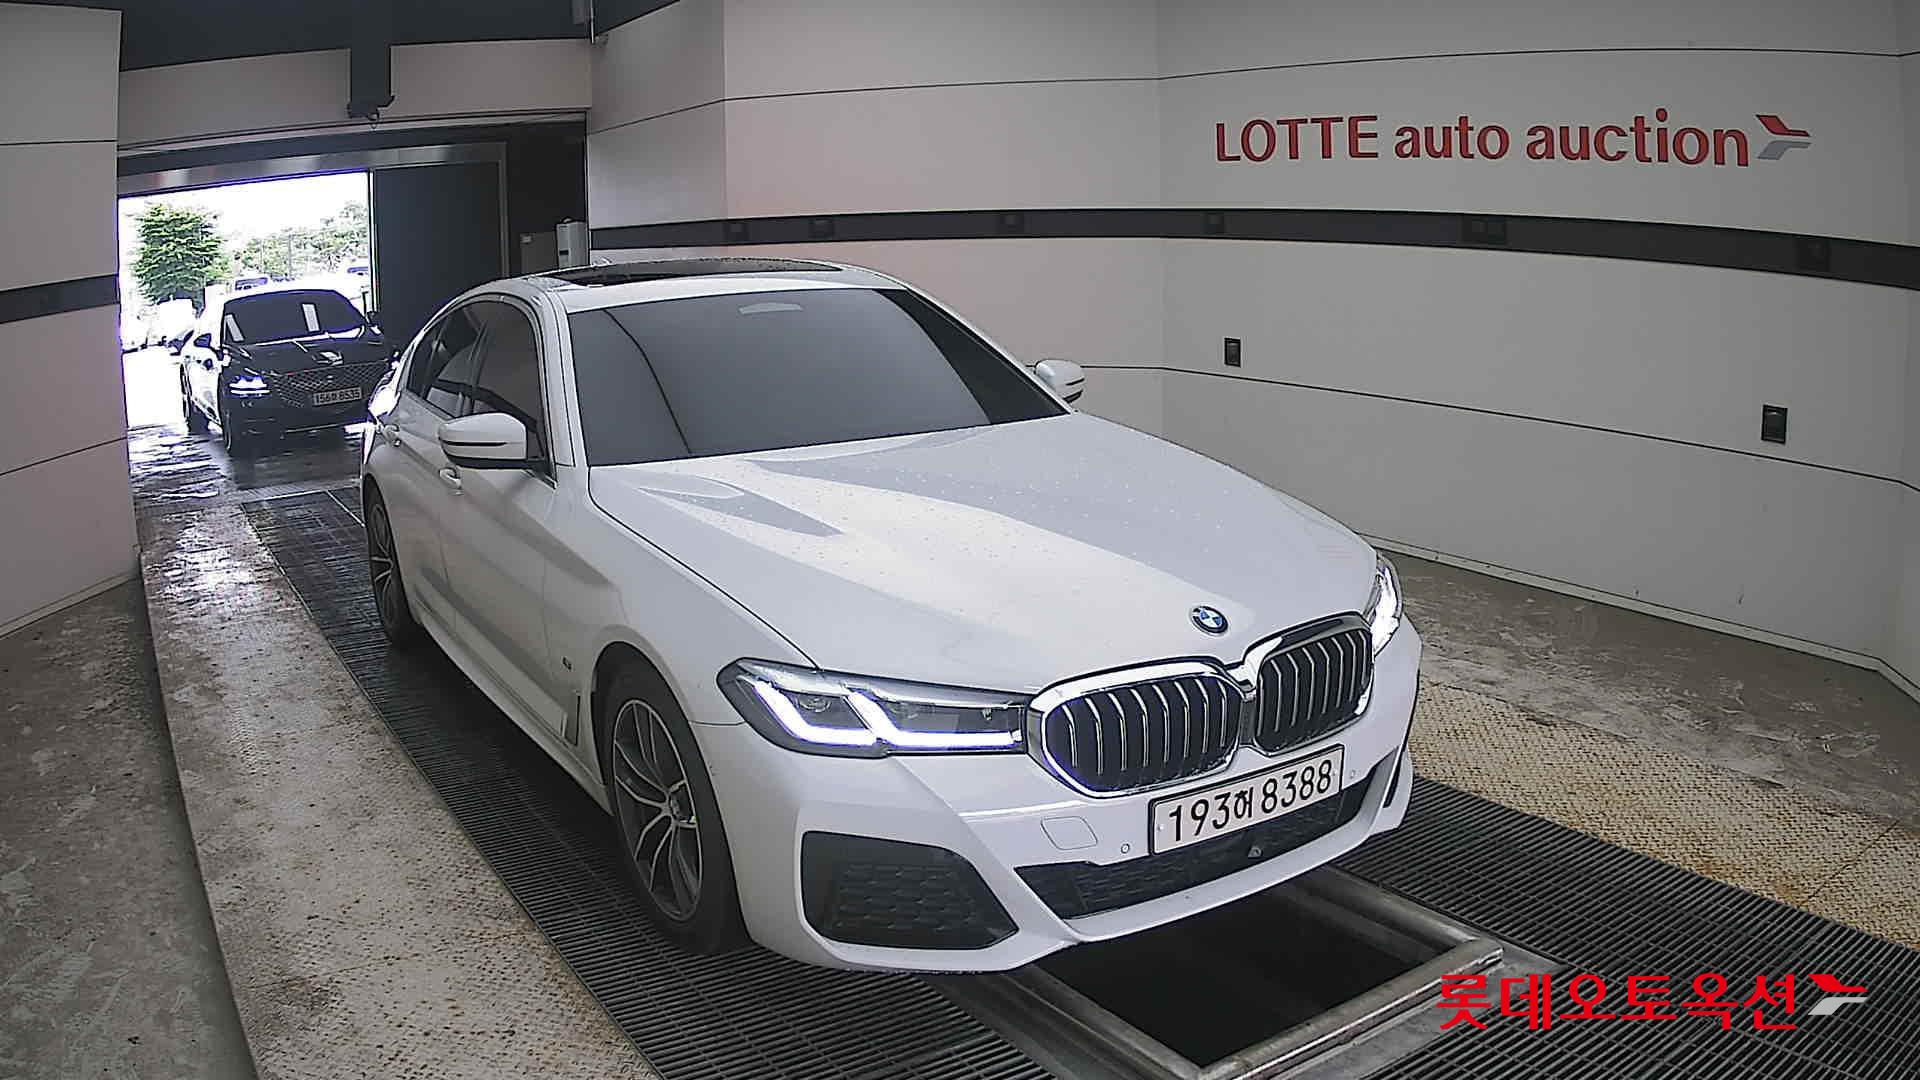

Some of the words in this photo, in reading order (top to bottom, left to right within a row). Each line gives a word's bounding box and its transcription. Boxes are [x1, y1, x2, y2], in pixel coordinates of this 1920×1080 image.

[1215, 115, 1379, 162] LOTTE
[1395, 115, 1510, 160] auto
[1526, 107, 1750, 167] auction
[1169, 786, 1254, 842] 193허
[1260, 759, 1332, 814] 8388
